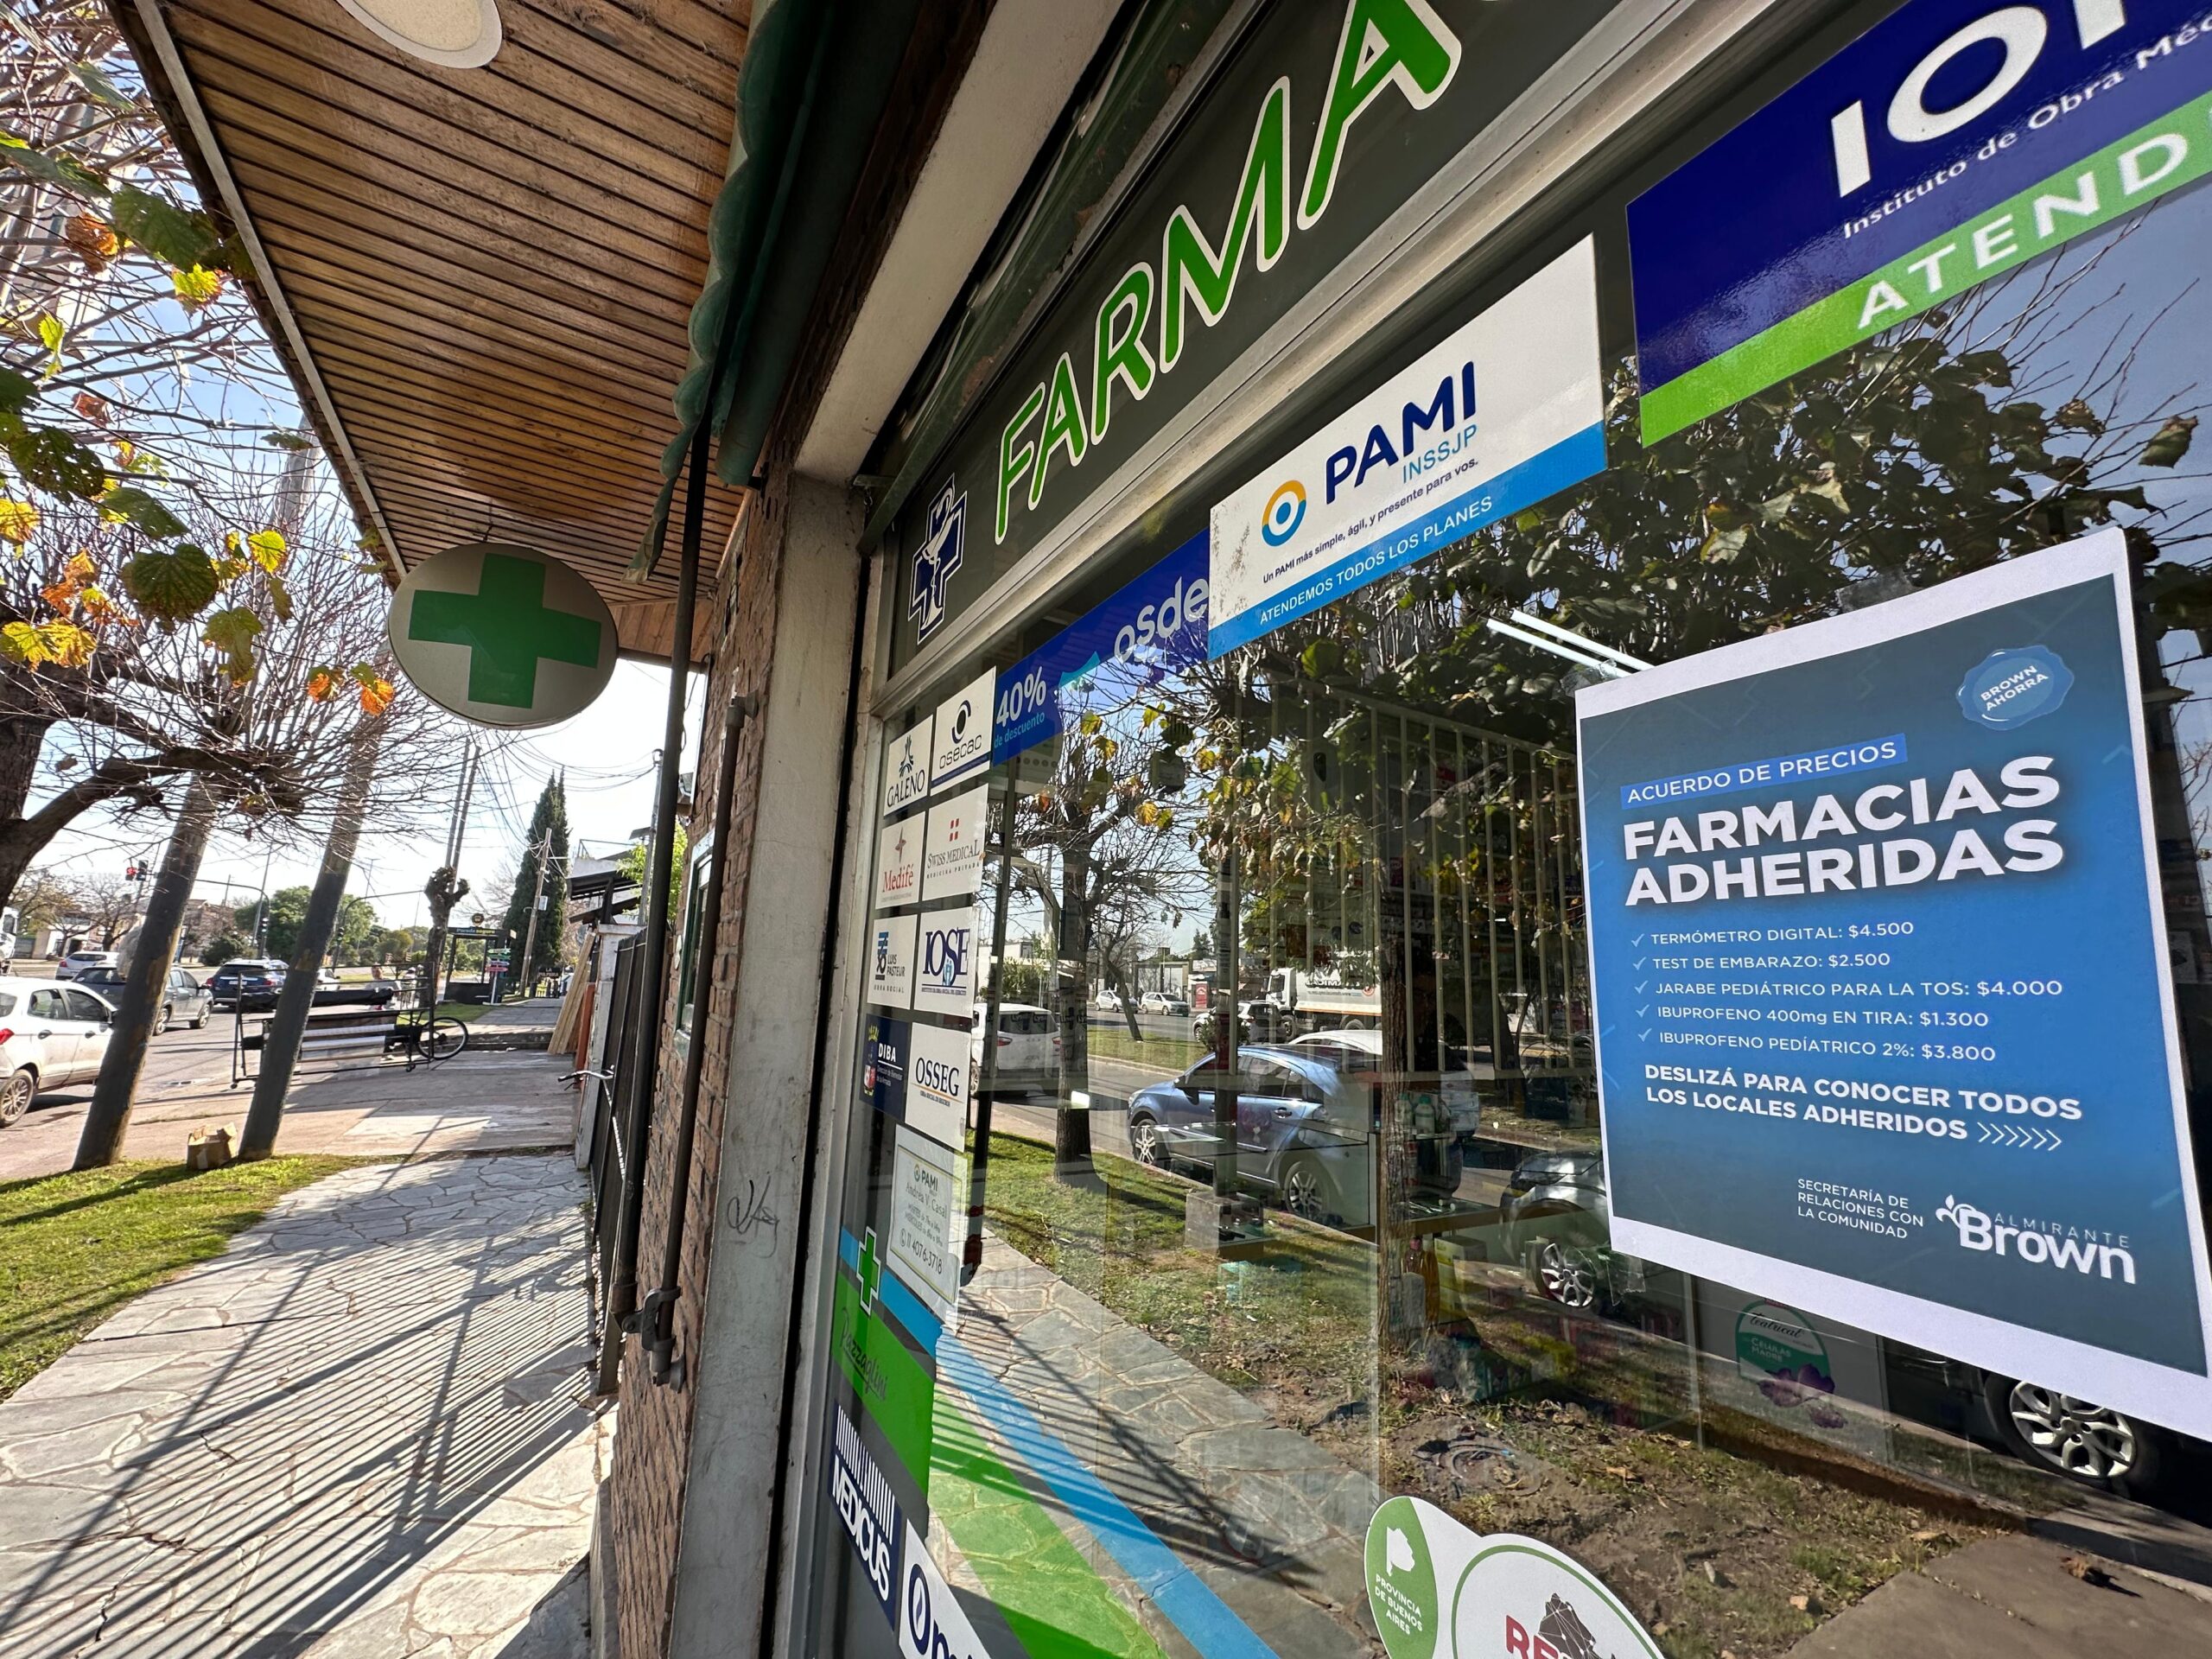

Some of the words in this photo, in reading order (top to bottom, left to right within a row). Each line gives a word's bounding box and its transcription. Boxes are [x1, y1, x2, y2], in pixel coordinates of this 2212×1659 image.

[1831, 0, 2126, 198] IO
[1844, 161, 1967, 238] Instituto
[1977, 130, 2018, 161] de
[2028, 71, 2125, 130] Obra
[1858, 105, 2212, 329] ATEND
[1325, 361, 1476, 505] PAMI
[1402, 424, 1477, 483] INSSJP
[1262, 572, 1274, 584] Un
[1274, 560, 1295, 581] PAMI
[1296, 550, 1313, 566] más
[1314, 532, 1346, 557] simple,
[1348, 518, 1368, 539] ágil,
[1369, 515, 1376, 527] y
[1377, 486, 1423, 520] presente
[1426, 472, 1452, 496] para
[1454, 459, 1479, 476] vos.
[1260, 577, 1333, 625] ATENDEMOS
[1336, 551, 1385, 585] TODOS
[1389, 534, 1419, 559] LOS
[1423, 496, 1493, 543] PLANES
[1115, 576, 1209, 664] osde
[996, 666, 1046, 727] 40%
[1980, 664, 2038, 702] BROWN
[1986, 672, 2049, 712] AHORRA
[994, 734, 1003, 749] de
[1005, 709, 1046, 746] descuento
[939, 734, 982, 770] osecac
[887, 769, 925, 808] GALENO
[1627, 772, 1731, 804] ACUERDO
[1739, 766, 1770, 785] DE
[1780, 741, 1897, 779] PRECIOS
[1624, 755, 2061, 861] FARMACIAS
[882, 864, 914, 893] Medifé
[1625, 819, 2064, 907] ADHERIDAS
[1650, 929, 1761, 944] TERMÓMETRO
[1767, 925, 1843, 941] DIGITAL:
[1848, 921, 1914, 939] $4.500
[887, 954, 897, 964] LUIS
[887, 966, 906, 977] PASTEUR
[923, 927, 970, 987] IOSE
[1653, 958, 1688, 969] TEST
[1694, 957, 1715, 969] DE
[1719, 956, 1823, 969] EMBARAZO:
[1827, 952, 1891, 968] $2.500
[1656, 982, 1716, 995] JARABE
[1721, 979, 1825, 996] PEDIÁTRICO
[1831, 982, 1882, 996] PARA
[1888, 982, 1915, 996] LA
[1921, 982, 1969, 996] TOS:
[1977, 980, 2063, 997] $4.000
[1657, 1006, 1761, 1021] IBUPROFENO
[1766, 1009, 1827, 1026] 400mg
[1833, 1011, 1857, 1025] EN
[1862, 1011, 1914, 1026] TIRA:
[1919, 1011, 1989, 1027] $1.300
[878, 1043, 896, 1063] DIBA
[1659, 1032, 1764, 1049] IBUPROFENO
[1769, 1036, 1876, 1055] PEDÍATRICO
[1882, 1043, 1916, 1058] 2%:
[1921, 1043, 1996, 1062] $3.800
[916, 1057, 959, 1097] OSSEG
[1644, 1064, 1738, 1087] DESLIZÁ
[1743, 1072, 1808, 1094] PARA
[1814, 1078, 1950, 1108] CONOCER
[1958, 1090, 2082, 1120] TODOS
[1646, 1087, 1688, 1106] LOS
[1693, 1091, 1796, 1119] LOCALES
[1802, 1104, 1968, 1141] ADHERIDOS
[921, 1169, 938, 1192] PAMI
[1797, 1178, 1884, 1205] SECRETARÍA
[1888, 1196, 1909, 1209] DE
[1797, 1192, 1885, 1219] RELACIONES
[1890, 1211, 1923, 1227] CON
[1797, 1206, 1815, 1218] LA
[1818, 1211, 1908, 1239] COMUNIDAD
[1957, 1207, 2136, 1285] Brown
[1994, 1212, 2130, 1249] ALMIRANTE
[912, 1239, 943, 1274] 4076-3718
[832, 1453, 890, 1602] MEDICUS
[1375, 1586, 1386, 1601] DE
[1387, 1596, 1423, 1632] BUENOS
[1376, 1573, 1421, 1618] PROVINCIA
[1385, 1611, 1410, 1635] AIRES
